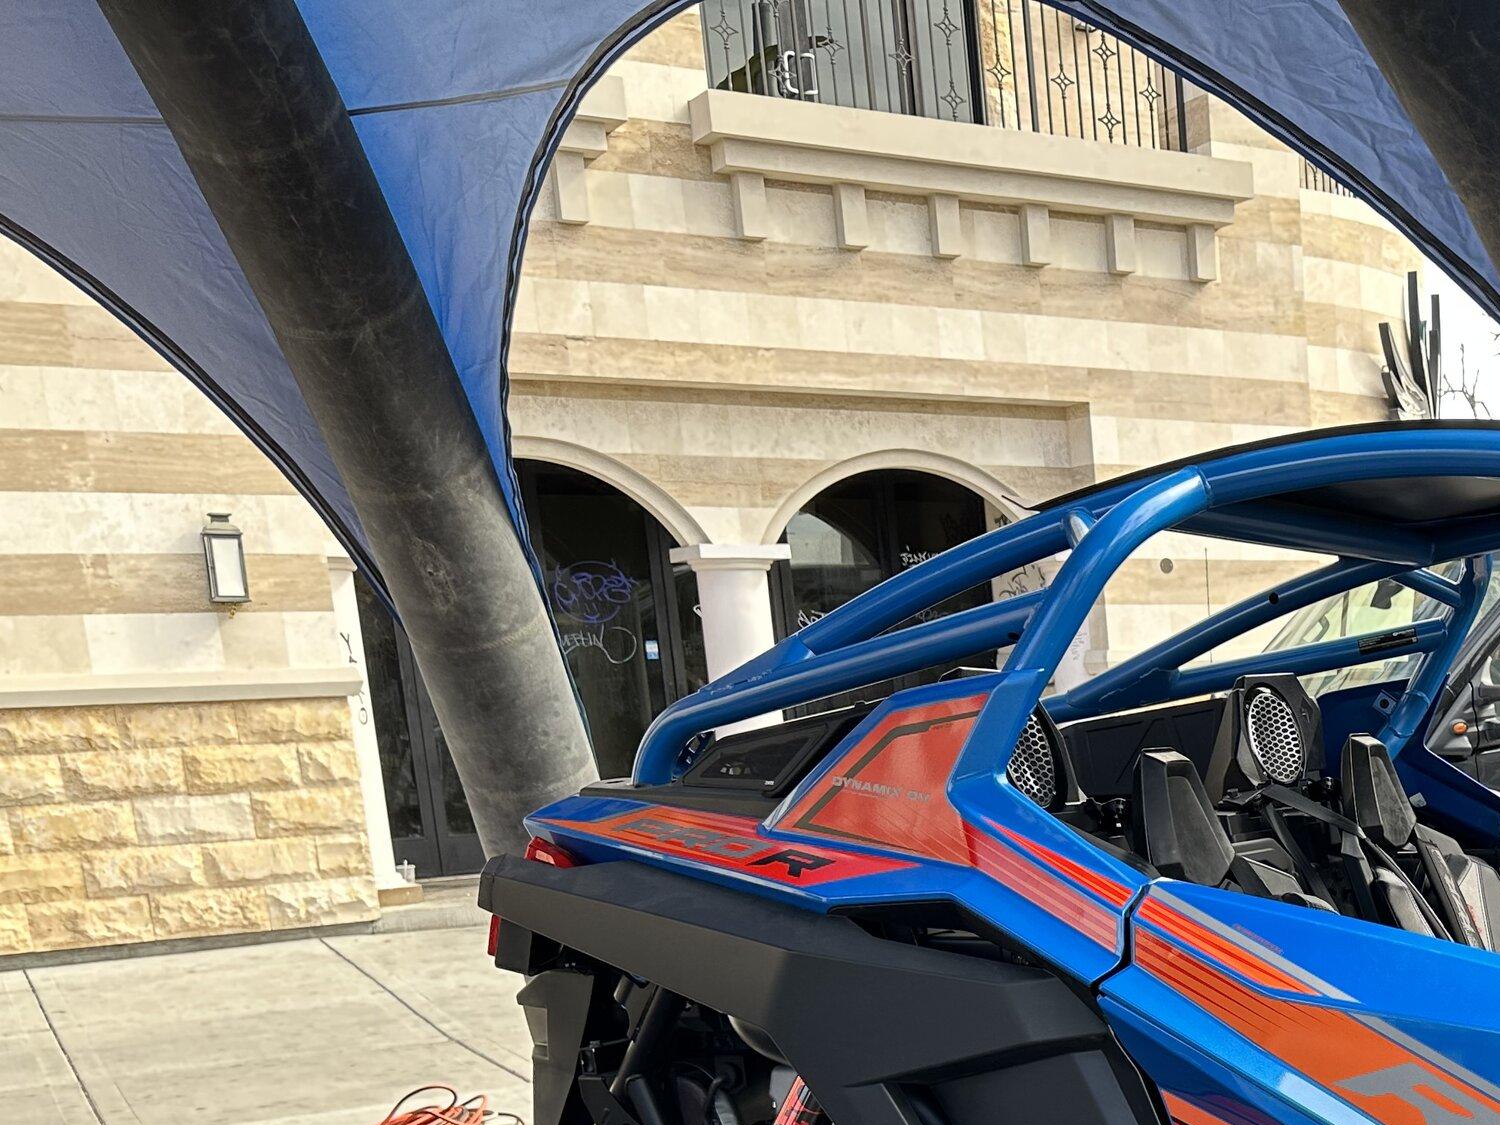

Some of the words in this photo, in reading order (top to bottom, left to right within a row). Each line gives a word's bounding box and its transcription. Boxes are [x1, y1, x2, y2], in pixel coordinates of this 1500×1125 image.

[832, 776, 903, 797] DYNAMIX
[612, 818, 774, 859] PRO
[745, 848, 837, 879] R
